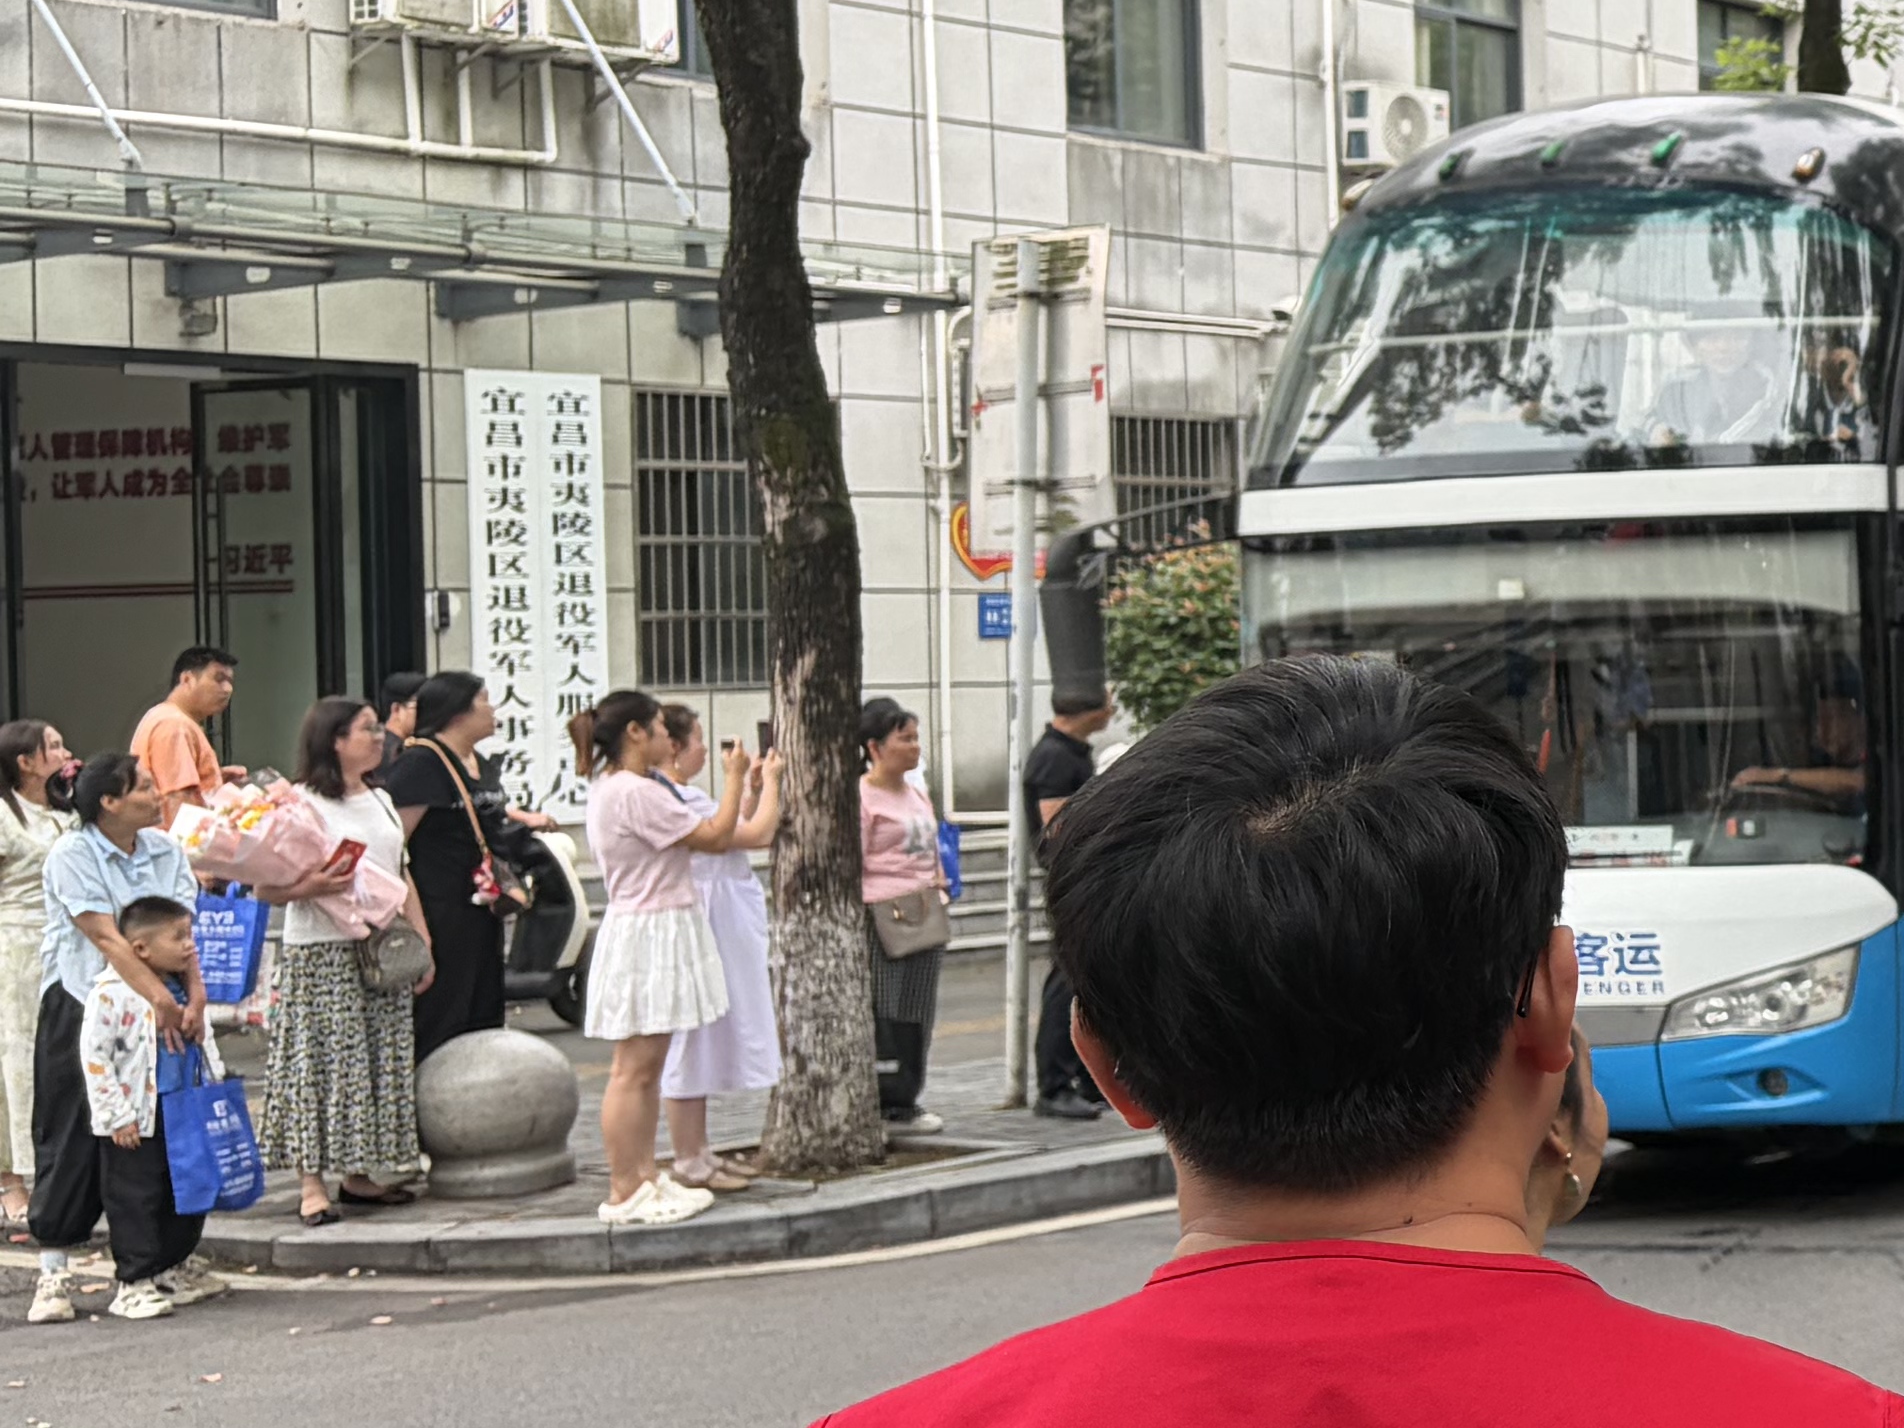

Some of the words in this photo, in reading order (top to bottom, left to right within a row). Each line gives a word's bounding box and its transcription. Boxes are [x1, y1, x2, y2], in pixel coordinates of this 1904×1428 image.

[547, 389, 597, 806] 宜昌市夷陵区退役军人服心
[1575, 932, 1663, 977] 客运
